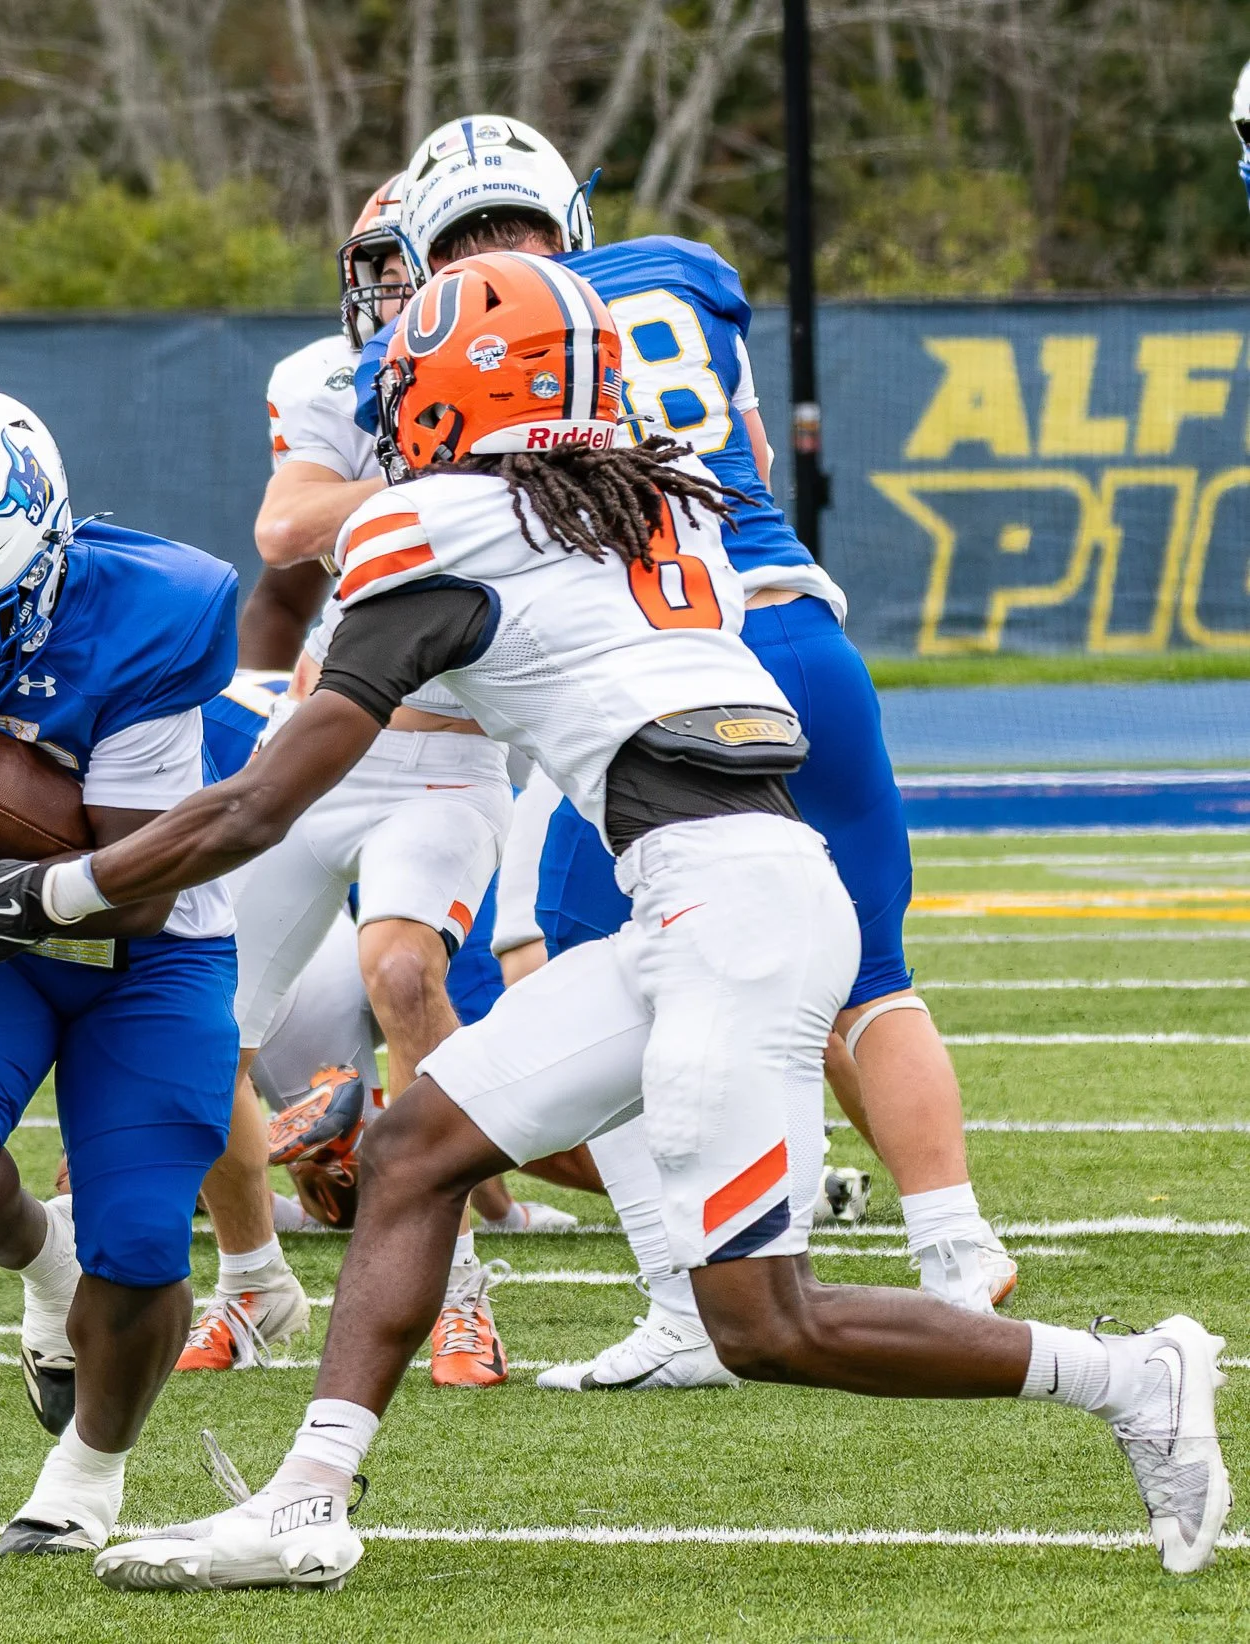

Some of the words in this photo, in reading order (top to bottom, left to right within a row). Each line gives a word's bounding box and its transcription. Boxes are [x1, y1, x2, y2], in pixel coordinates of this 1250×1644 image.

[484, 156, 502, 166] 88
[427, 206, 441, 228] TOP
[442, 197, 454, 211] OF
[457, 183, 479, 200] THE
[482, 182, 541, 200] MOUNTAIN
[610, 288, 733, 455] 8
[903, 332, 1250, 460] ALF
[526, 426, 615, 451] Riddell
[659, 1326, 683, 1343] ALPHA
[270, 1495, 333, 1538] NIKE
